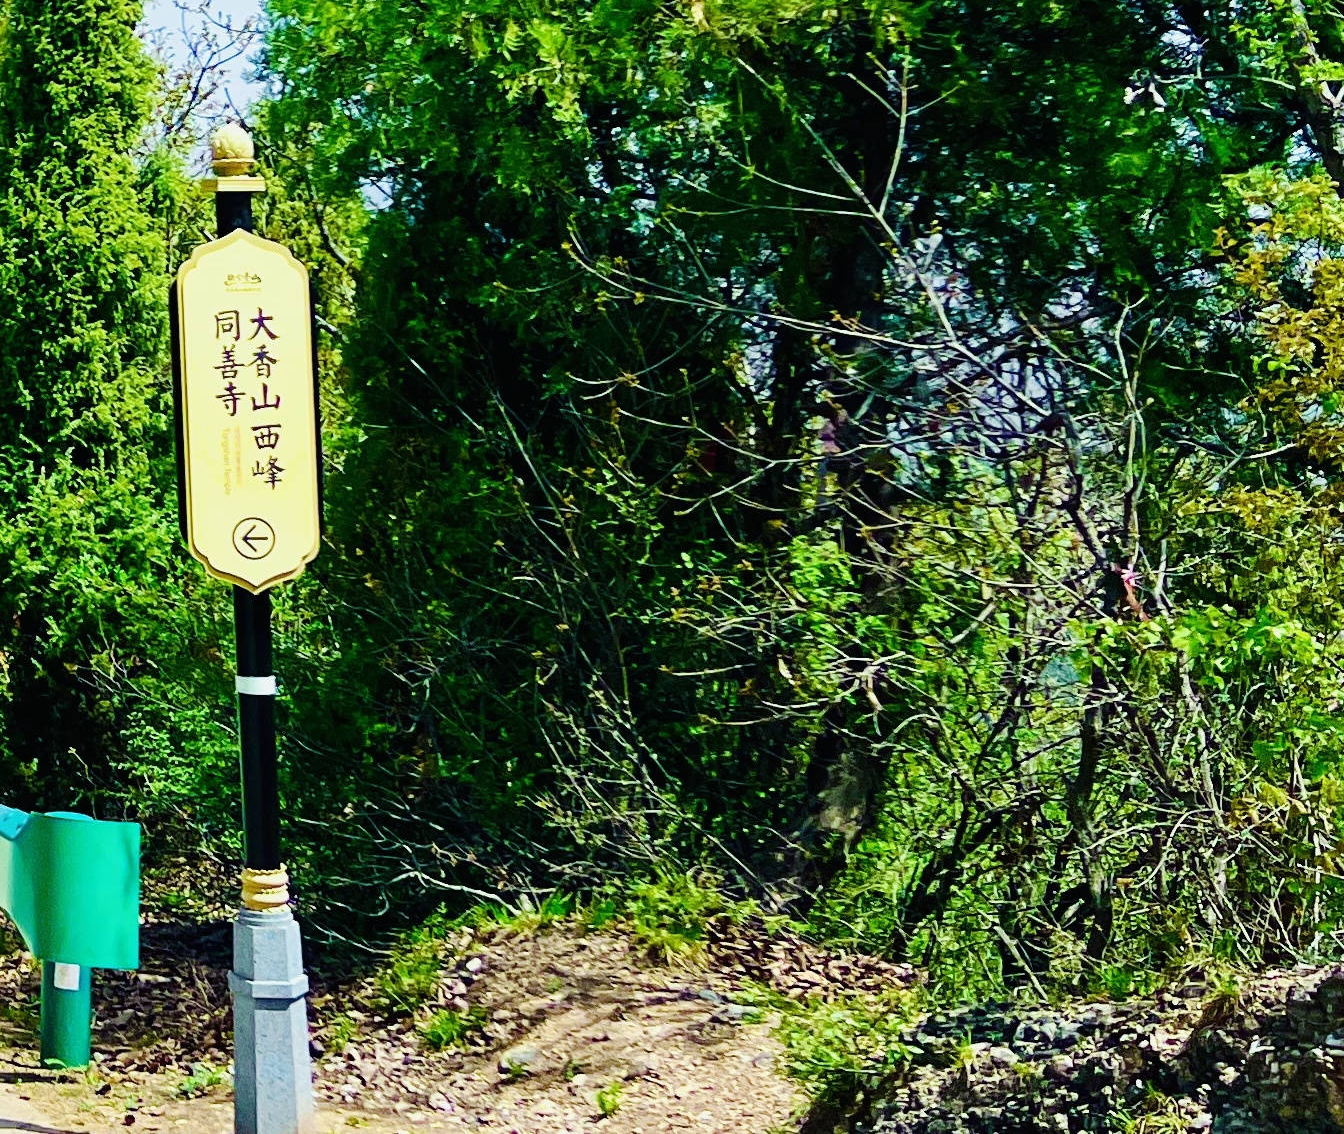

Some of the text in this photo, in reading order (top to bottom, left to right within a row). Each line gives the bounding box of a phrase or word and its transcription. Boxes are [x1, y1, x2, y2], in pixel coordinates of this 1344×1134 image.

[214, 310, 246, 417] 同善寺
[247, 307, 285, 490] 大香山西峰
